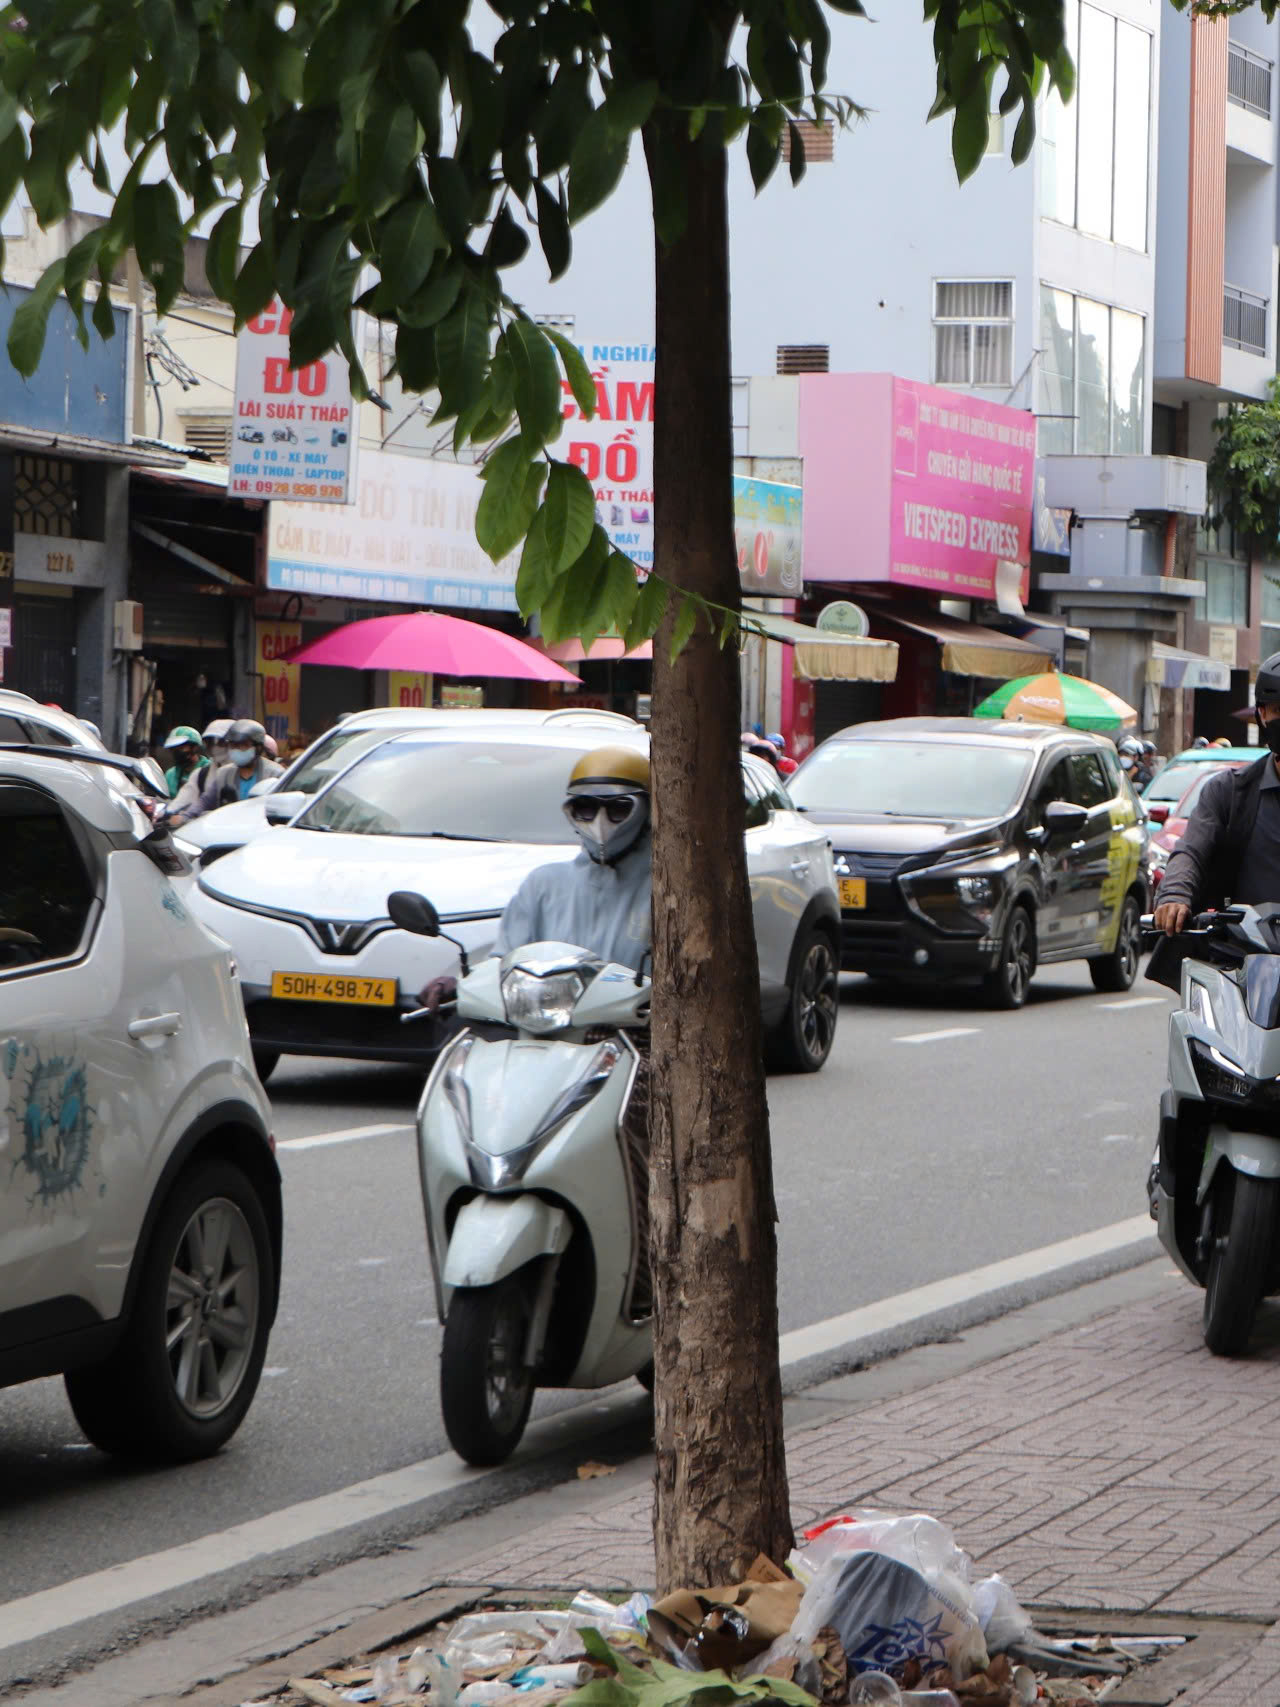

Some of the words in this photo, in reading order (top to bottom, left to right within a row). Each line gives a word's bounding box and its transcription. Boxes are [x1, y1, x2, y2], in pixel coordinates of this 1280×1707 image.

[567, 428, 638, 483] ĐỒ
[305, 468, 346, 481] LAPTOP
[620, 486, 656, 502] THẤ
[904, 501, 967, 548] VIETSPEED
[969, 516, 1019, 560] EXPRESS
[282, 976, 385, 1000] 50H-498.74
